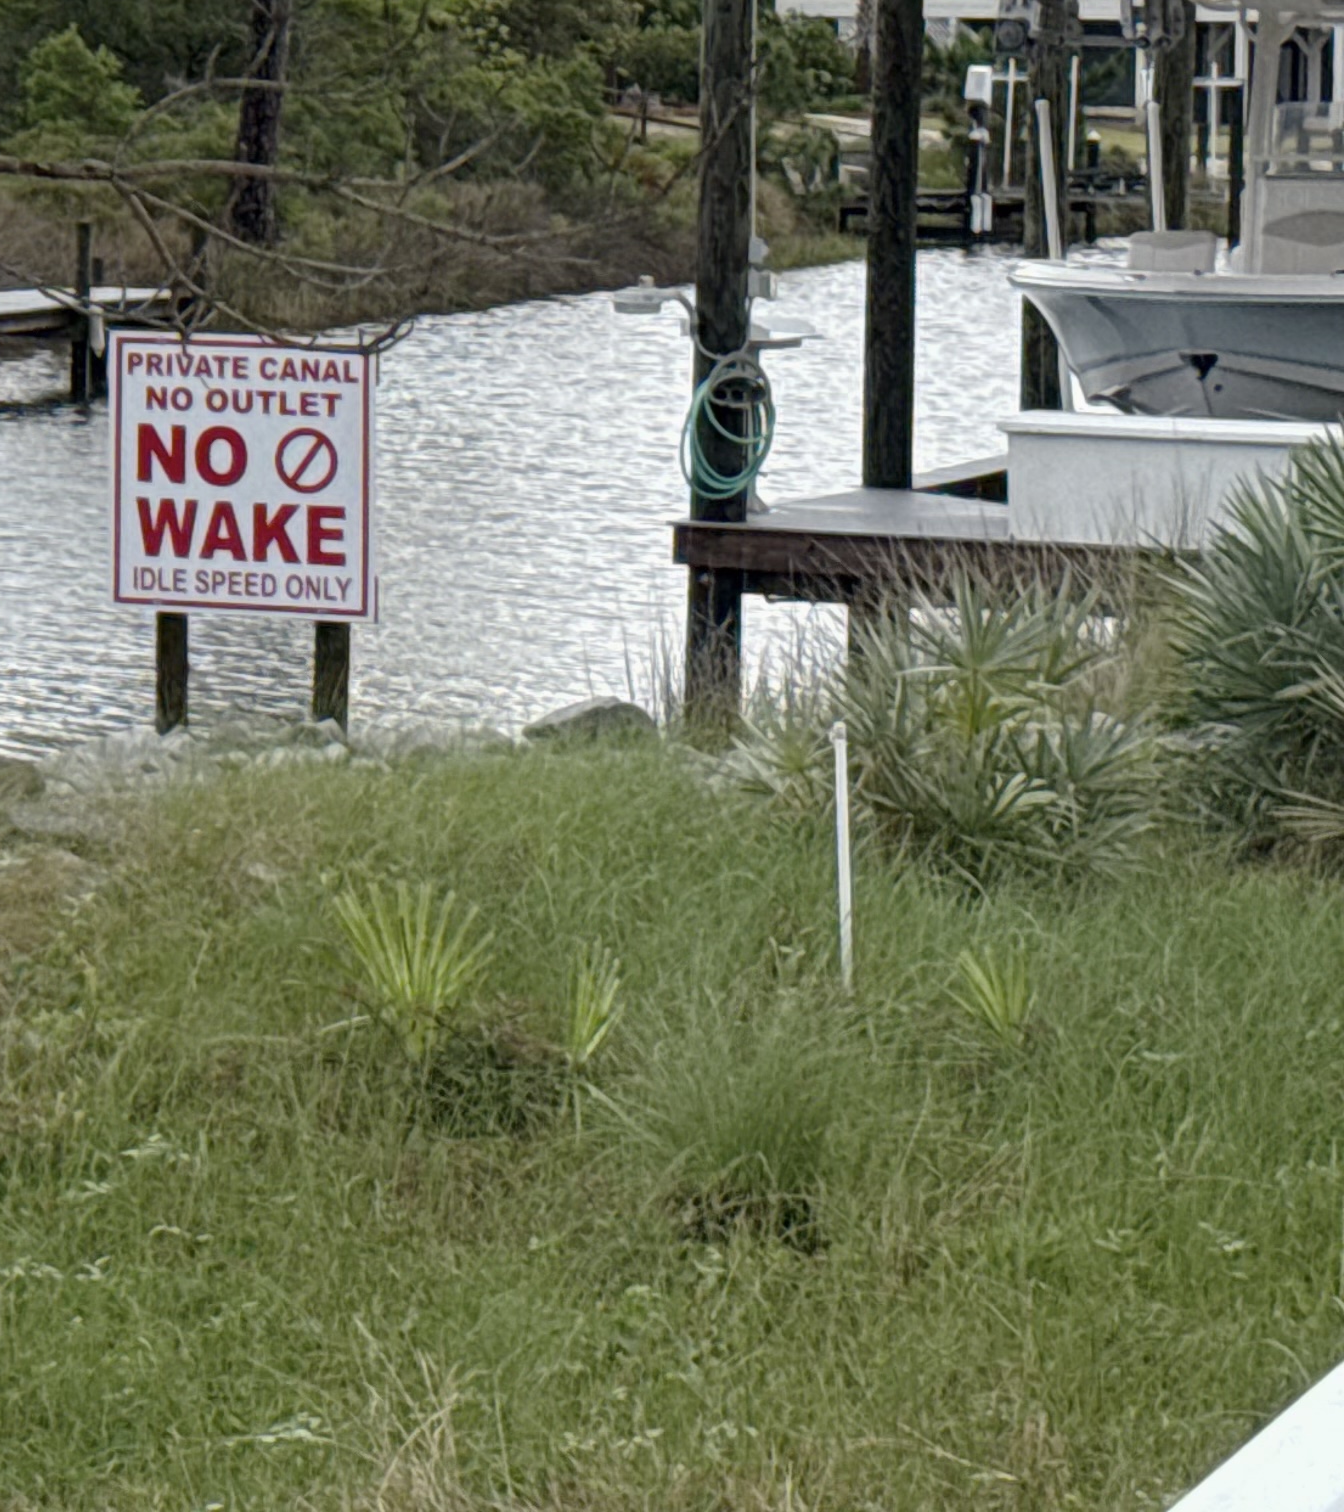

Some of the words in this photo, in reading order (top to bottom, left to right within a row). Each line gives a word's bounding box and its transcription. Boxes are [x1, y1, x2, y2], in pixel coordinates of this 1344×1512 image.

[127, 352, 249, 379] PRIVATE
[259, 357, 359, 383] CANAL
[145, 385, 193, 411] NO
[206, 388, 342, 417] OUTLET
[137, 423, 248, 486] NO
[136, 496, 346, 566] WAKE
[133, 566, 187, 594] IDLE
[195, 569, 277, 598] SPEED
[286, 574, 352, 602] ONLY
